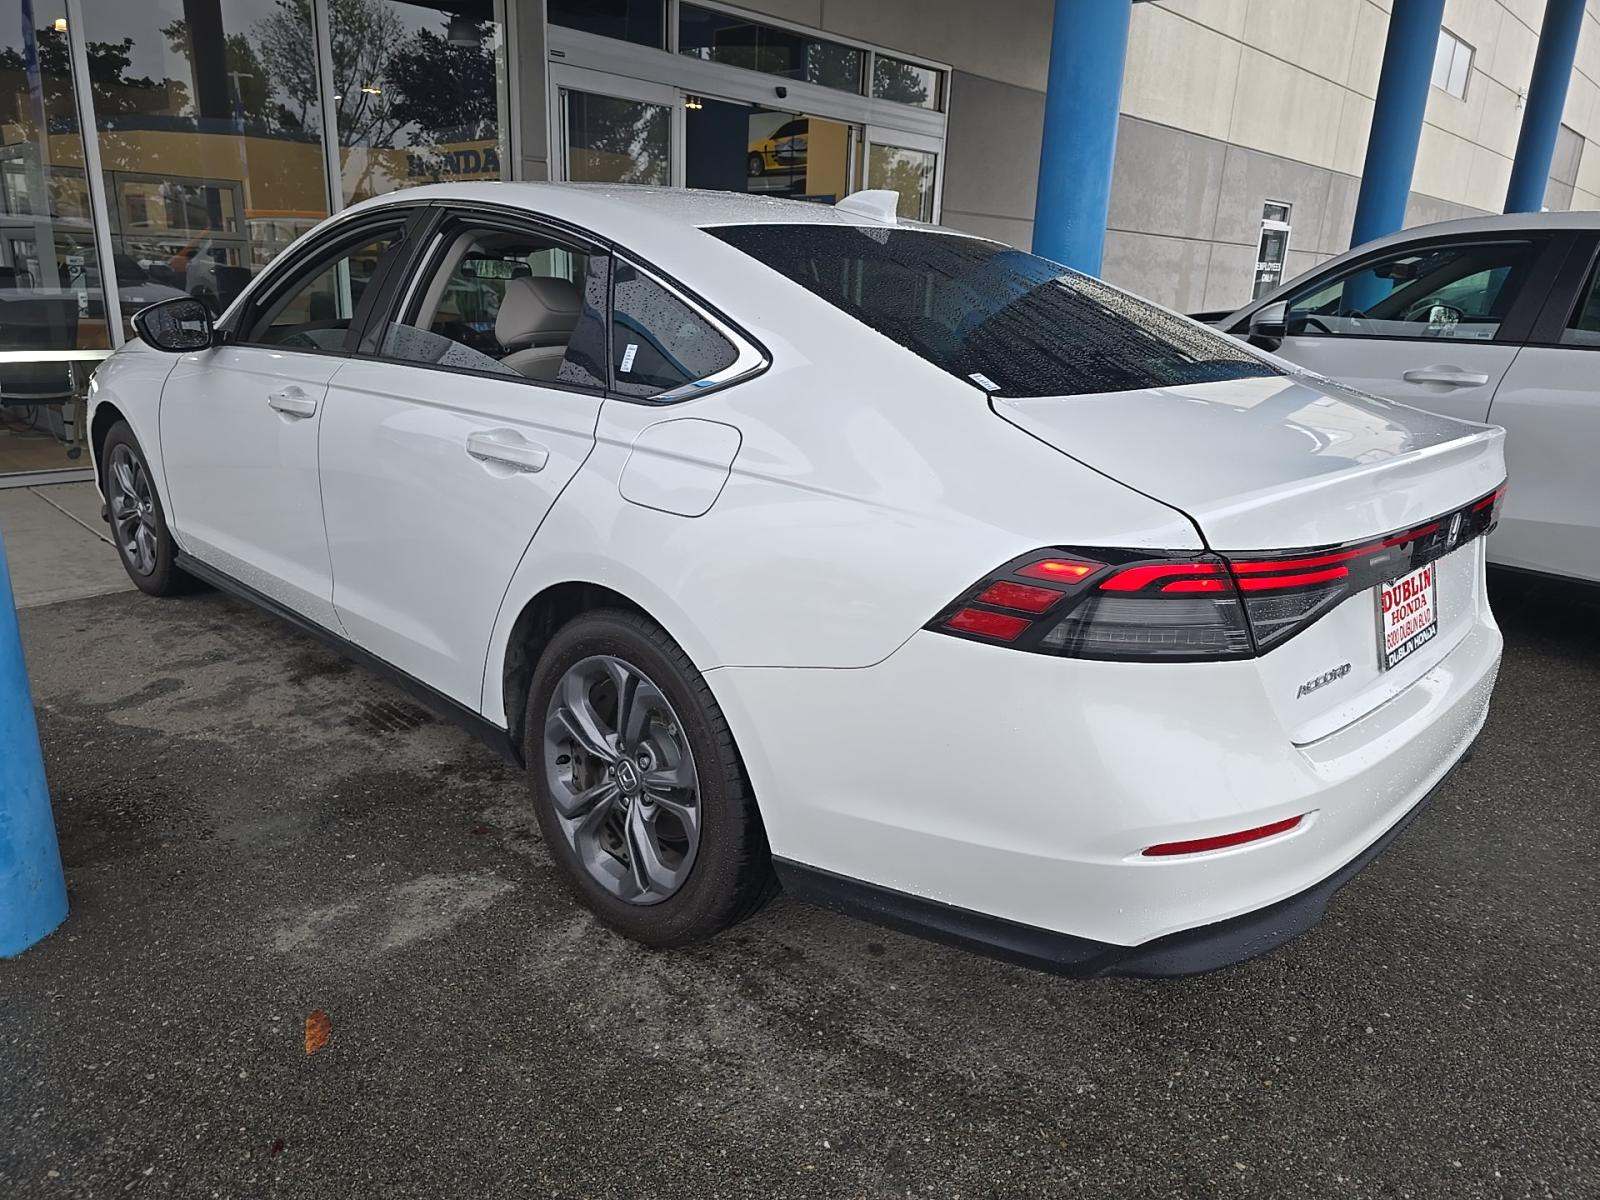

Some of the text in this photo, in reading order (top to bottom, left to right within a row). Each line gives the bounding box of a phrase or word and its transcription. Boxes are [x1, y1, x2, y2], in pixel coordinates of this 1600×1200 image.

[1381, 568, 1431, 613] DUBLIN
[1391, 594, 1427, 626] HONDA
[1389, 624, 1436, 667] DUBLIN HONDA
[1297, 663, 1351, 699] ACCORD
